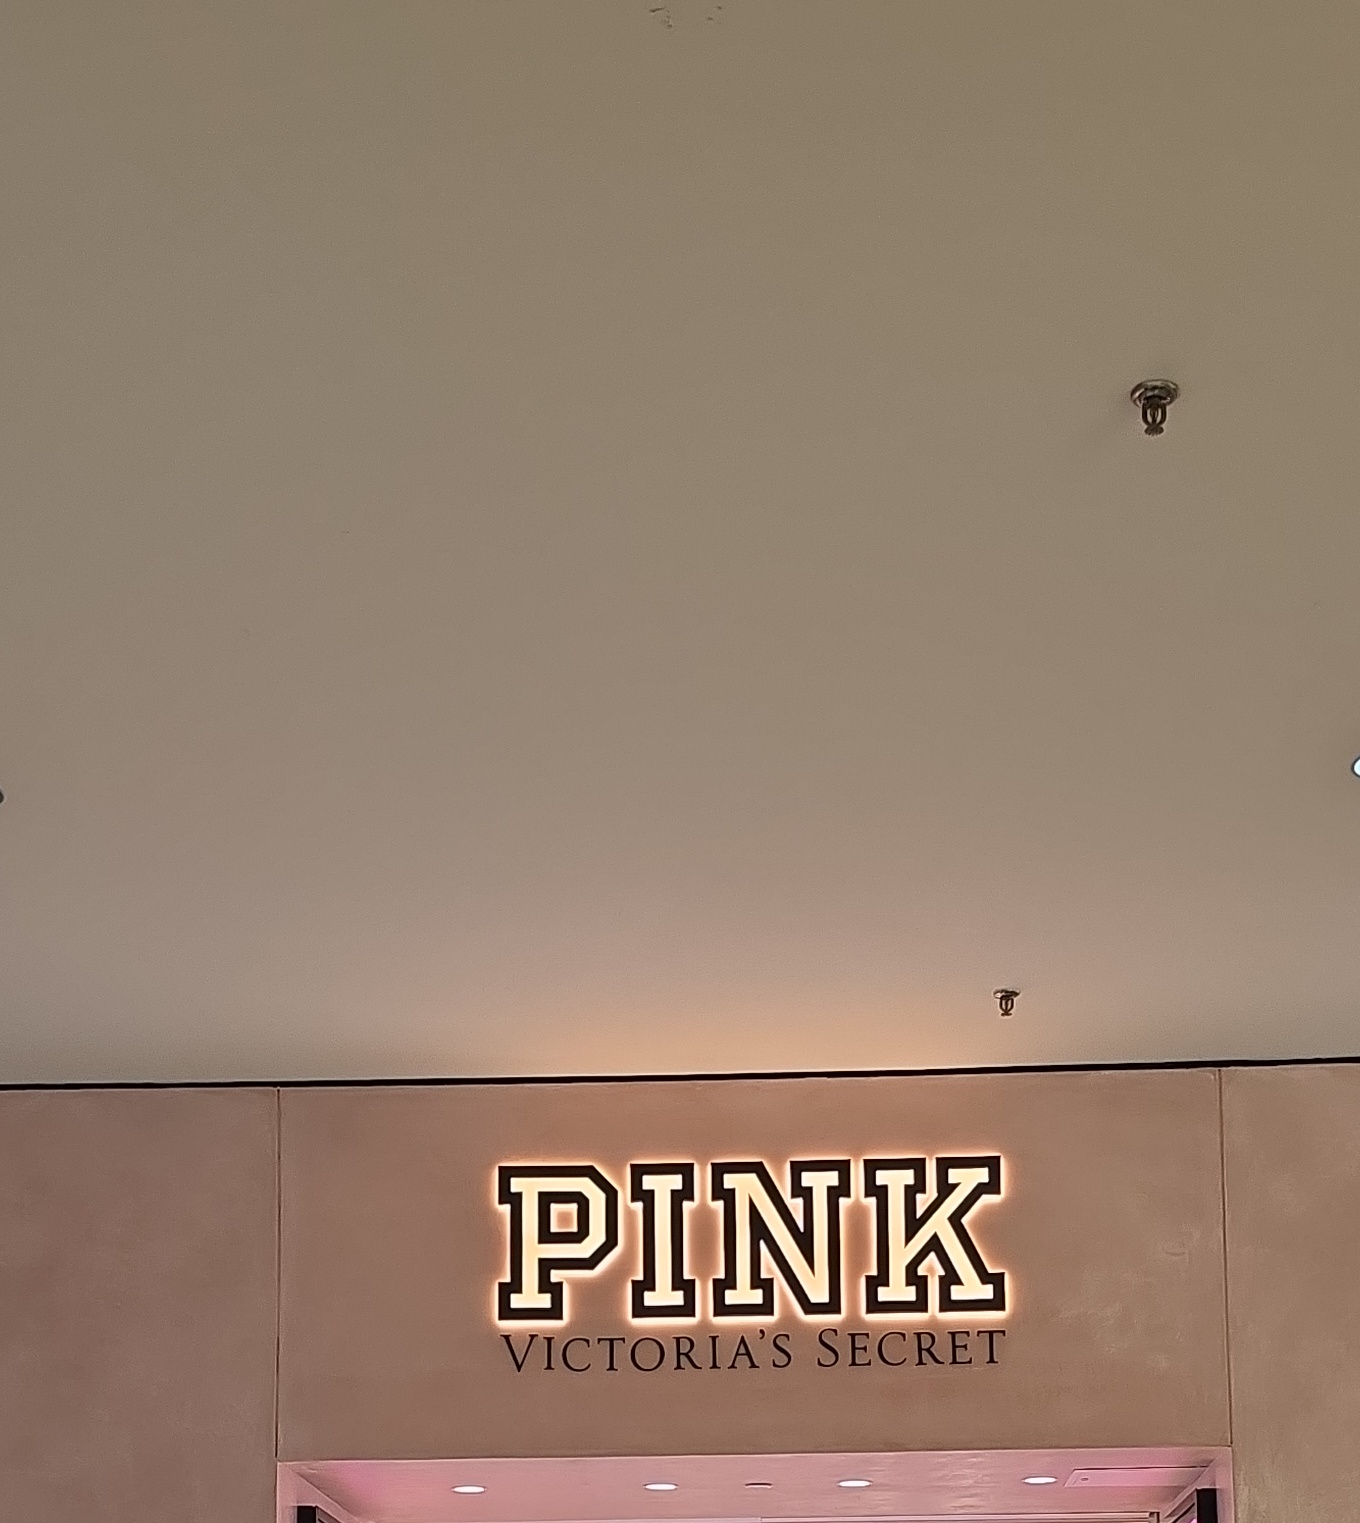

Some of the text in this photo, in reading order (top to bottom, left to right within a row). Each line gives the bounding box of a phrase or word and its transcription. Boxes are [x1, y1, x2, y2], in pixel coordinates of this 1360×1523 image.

[498, 1155, 1006, 1321] PINK
[500, 1328, 1006, 1373] VICTORIA'S SECRET
